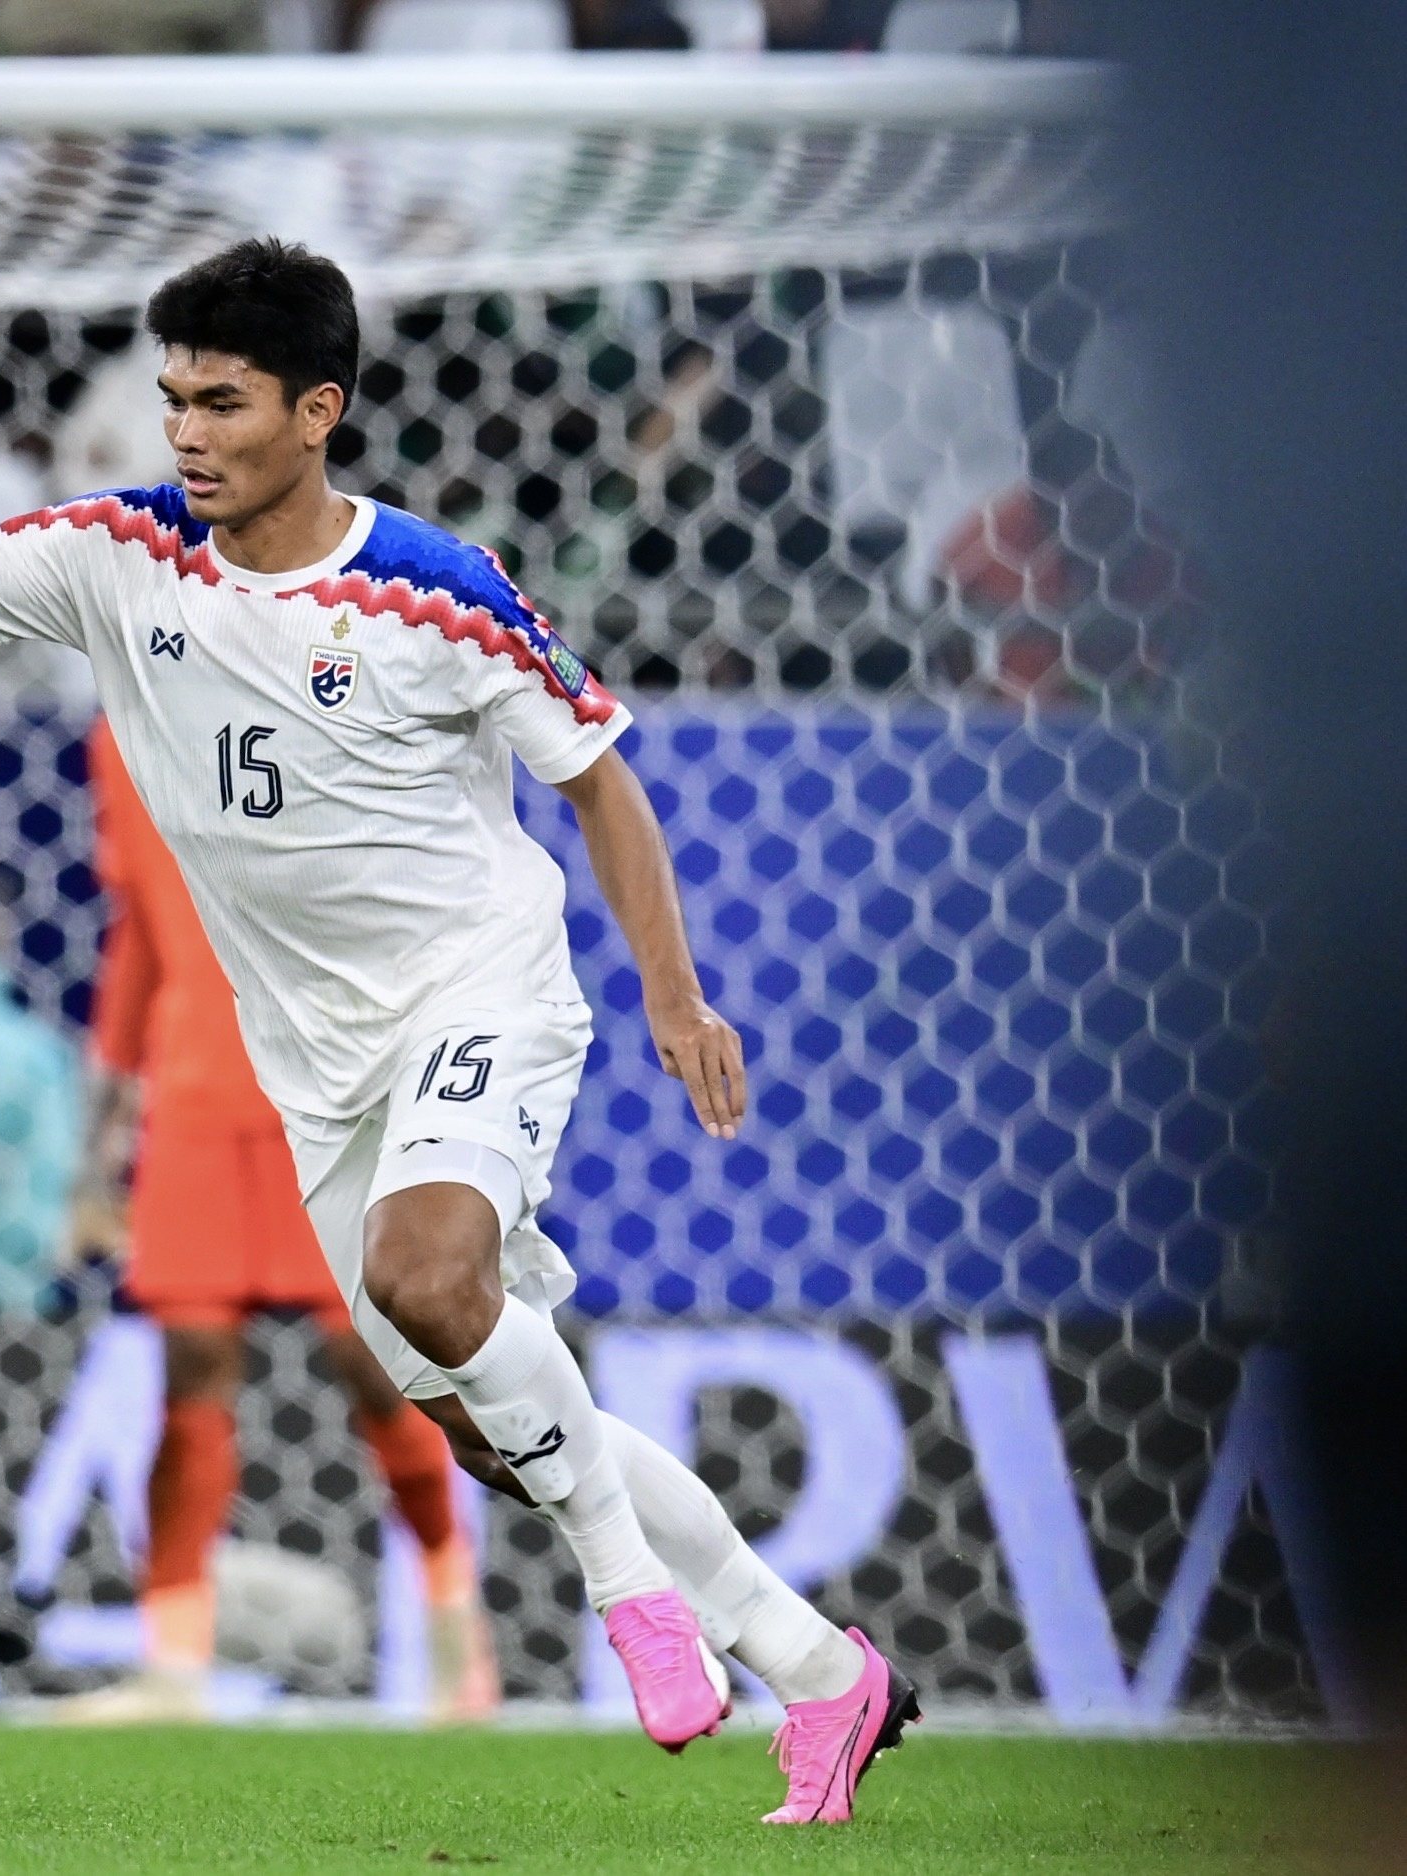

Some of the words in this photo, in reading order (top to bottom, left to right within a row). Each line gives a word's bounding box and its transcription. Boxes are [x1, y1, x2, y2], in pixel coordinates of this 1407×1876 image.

[314, 651, 354, 664] THAILAND
[213, 721, 284, 819] 15
[414, 1034, 502, 1104] 15
